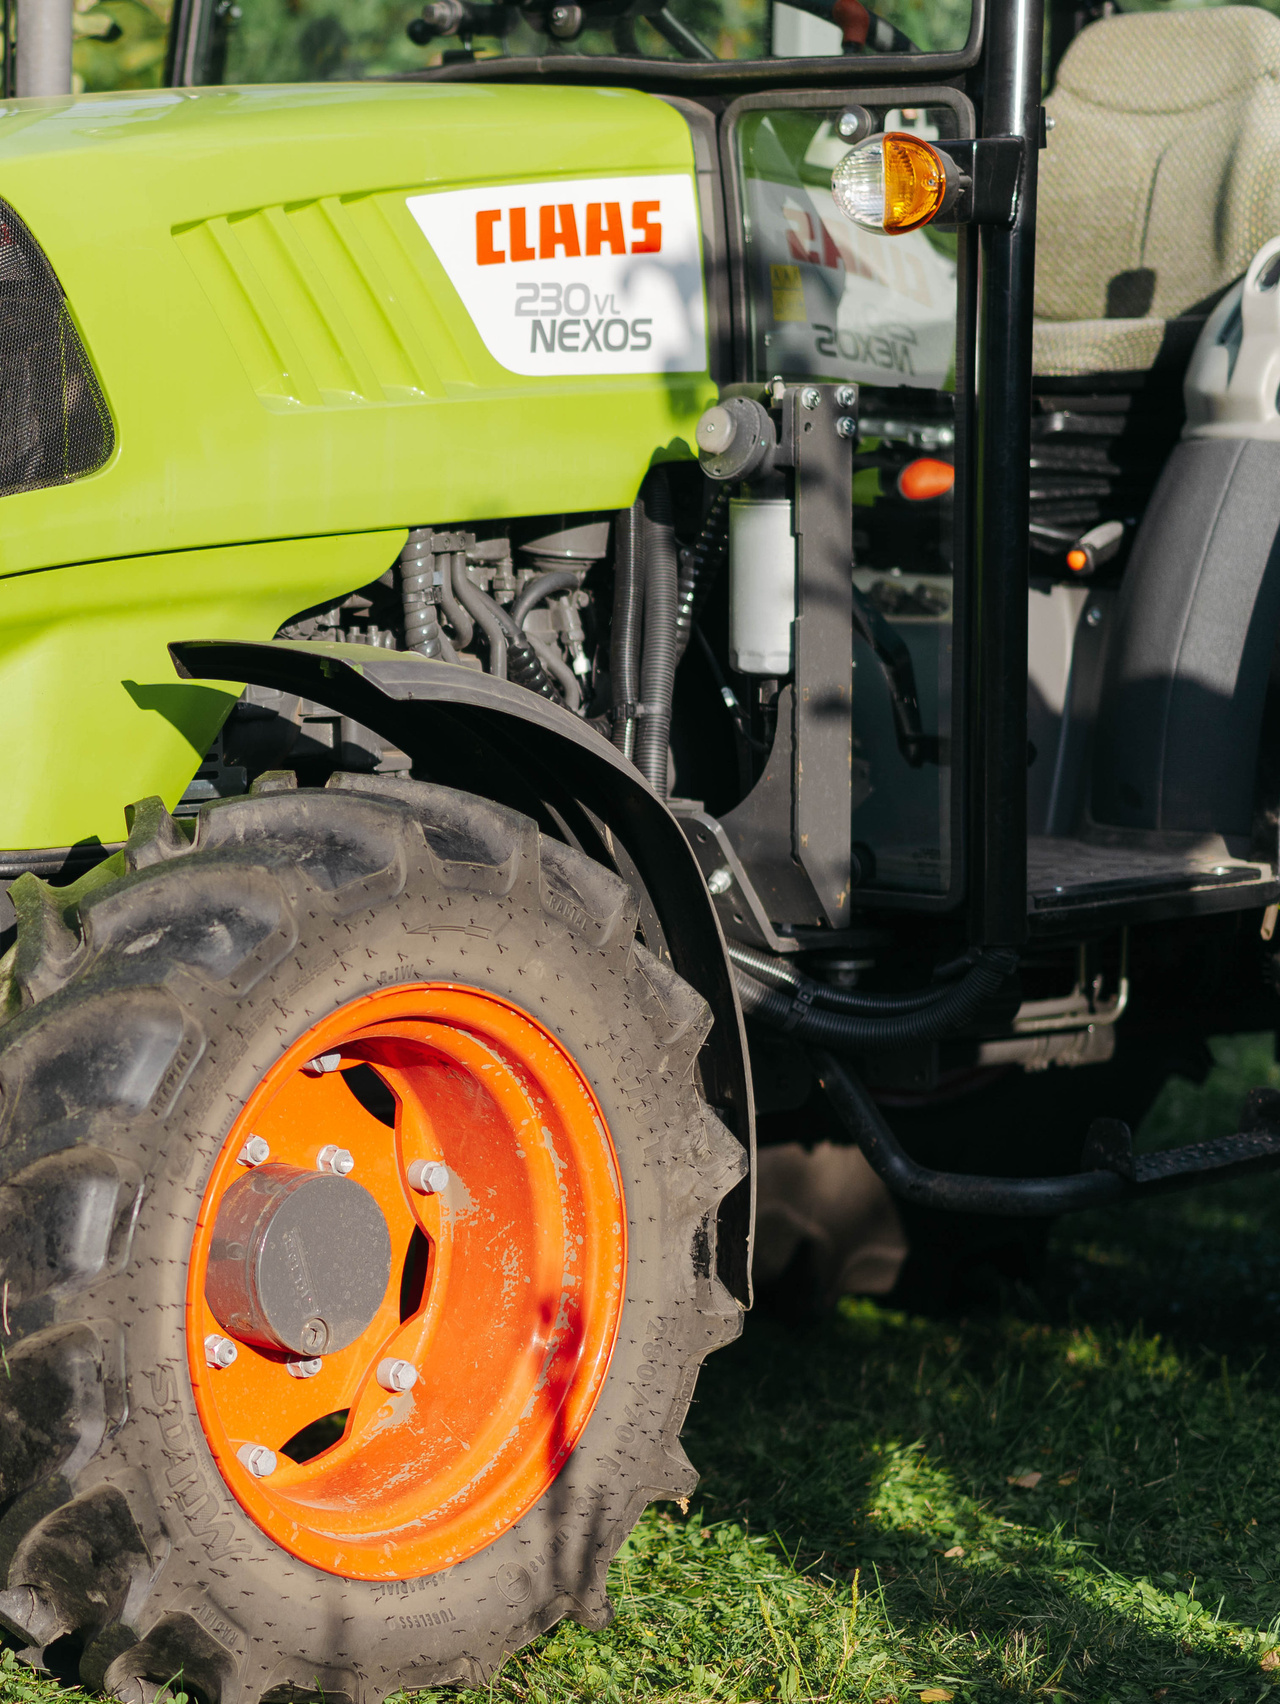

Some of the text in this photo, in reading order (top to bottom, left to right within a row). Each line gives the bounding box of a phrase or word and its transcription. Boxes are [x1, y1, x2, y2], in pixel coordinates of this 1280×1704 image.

[476, 200, 662, 266] CLAAS
[515, 282, 621, 316] 230 VL
[530, 318, 653, 353] NEXOS
[151, 1365, 253, 1562] Mitas
[398, 1607, 457, 1630] TUBELESS
